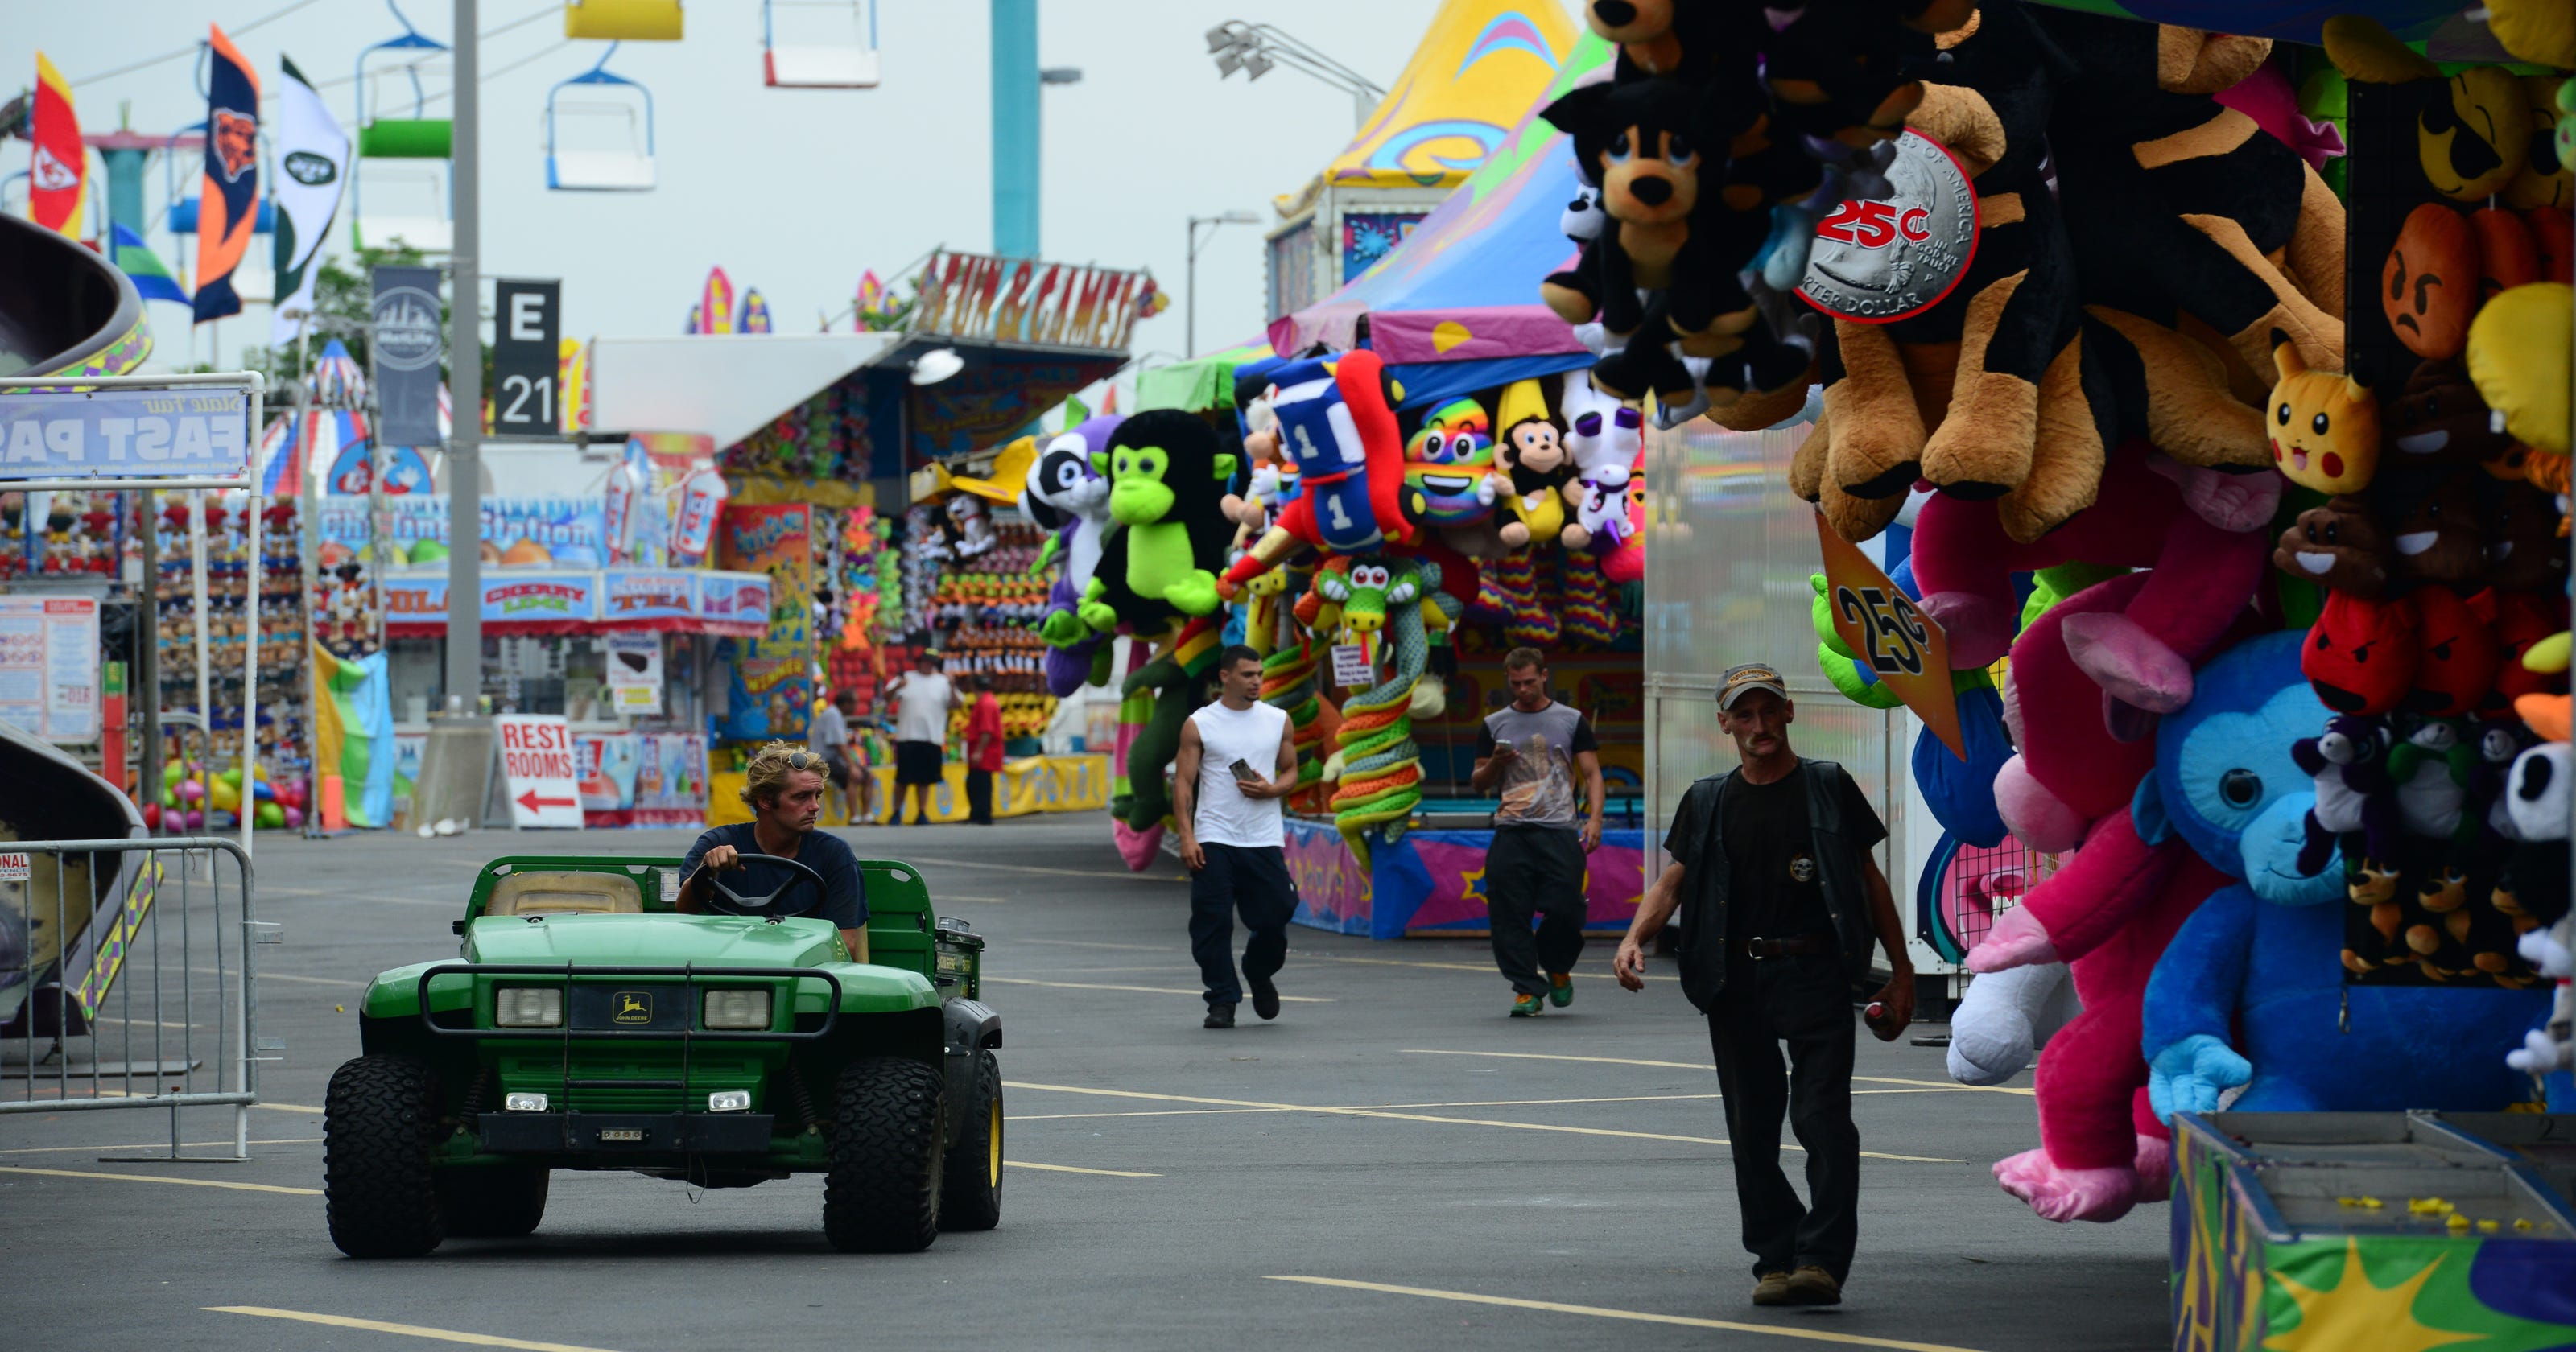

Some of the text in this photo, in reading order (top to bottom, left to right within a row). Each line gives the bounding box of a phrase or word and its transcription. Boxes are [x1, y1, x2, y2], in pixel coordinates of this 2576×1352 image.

[1924, 146, 1946, 164] OF
[1942, 168, 1973, 245] AMERICA
[1816, 199, 1931, 249] 25¢
[1916, 243, 1941, 258] GOD
[1918, 252, 1951, 273] TRUST
[1934, 239, 1949, 251] IN
[1030, 262, 1136, 349] GAMES
[1802, 276, 1923, 315] RTER DOLLAR
[510, 293, 546, 342] E
[502, 374, 552, 424] 21
[1293, 423, 1319, 459] 1
[1327, 493, 1353, 530] 1
[485, 583, 586, 604] CHERRY
[503, 597, 568, 614] LIME
[611, 594, 692, 612] TEA
[1836, 584, 1932, 676] 25¢
[502, 723, 567, 749] REST
[506, 752, 573, 778] ROOMS
